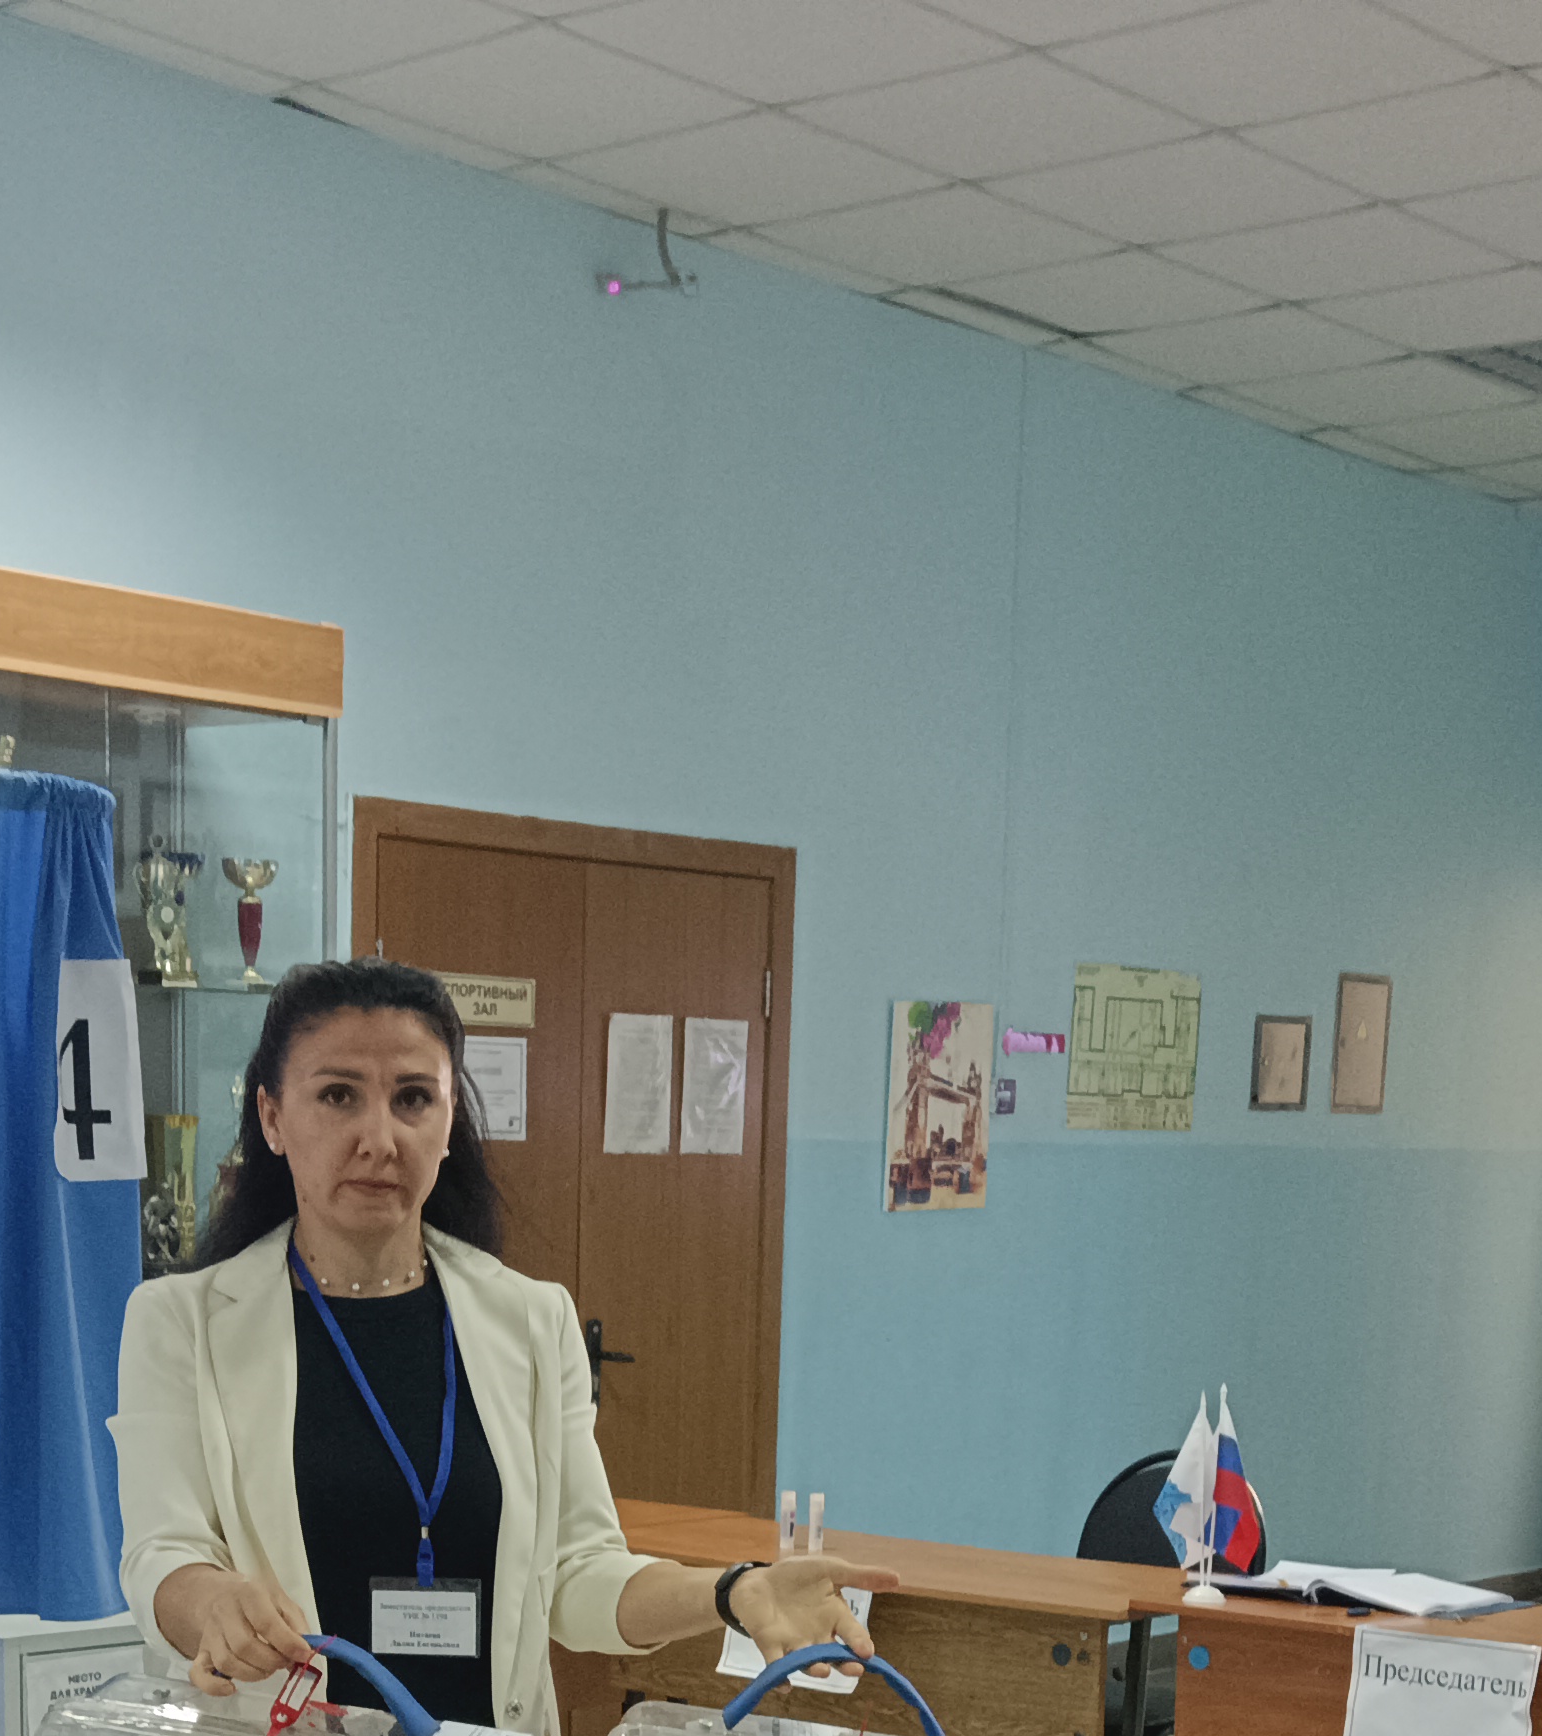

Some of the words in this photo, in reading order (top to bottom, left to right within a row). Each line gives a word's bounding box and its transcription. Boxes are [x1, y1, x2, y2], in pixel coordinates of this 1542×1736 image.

[472, 1001, 498, 1016] ЗАЛ
[59, 1018, 112, 1161] 4
[68, 1671, 102, 1684] МЕСТО
[1364, 1653, 1528, 1698] Председатель
